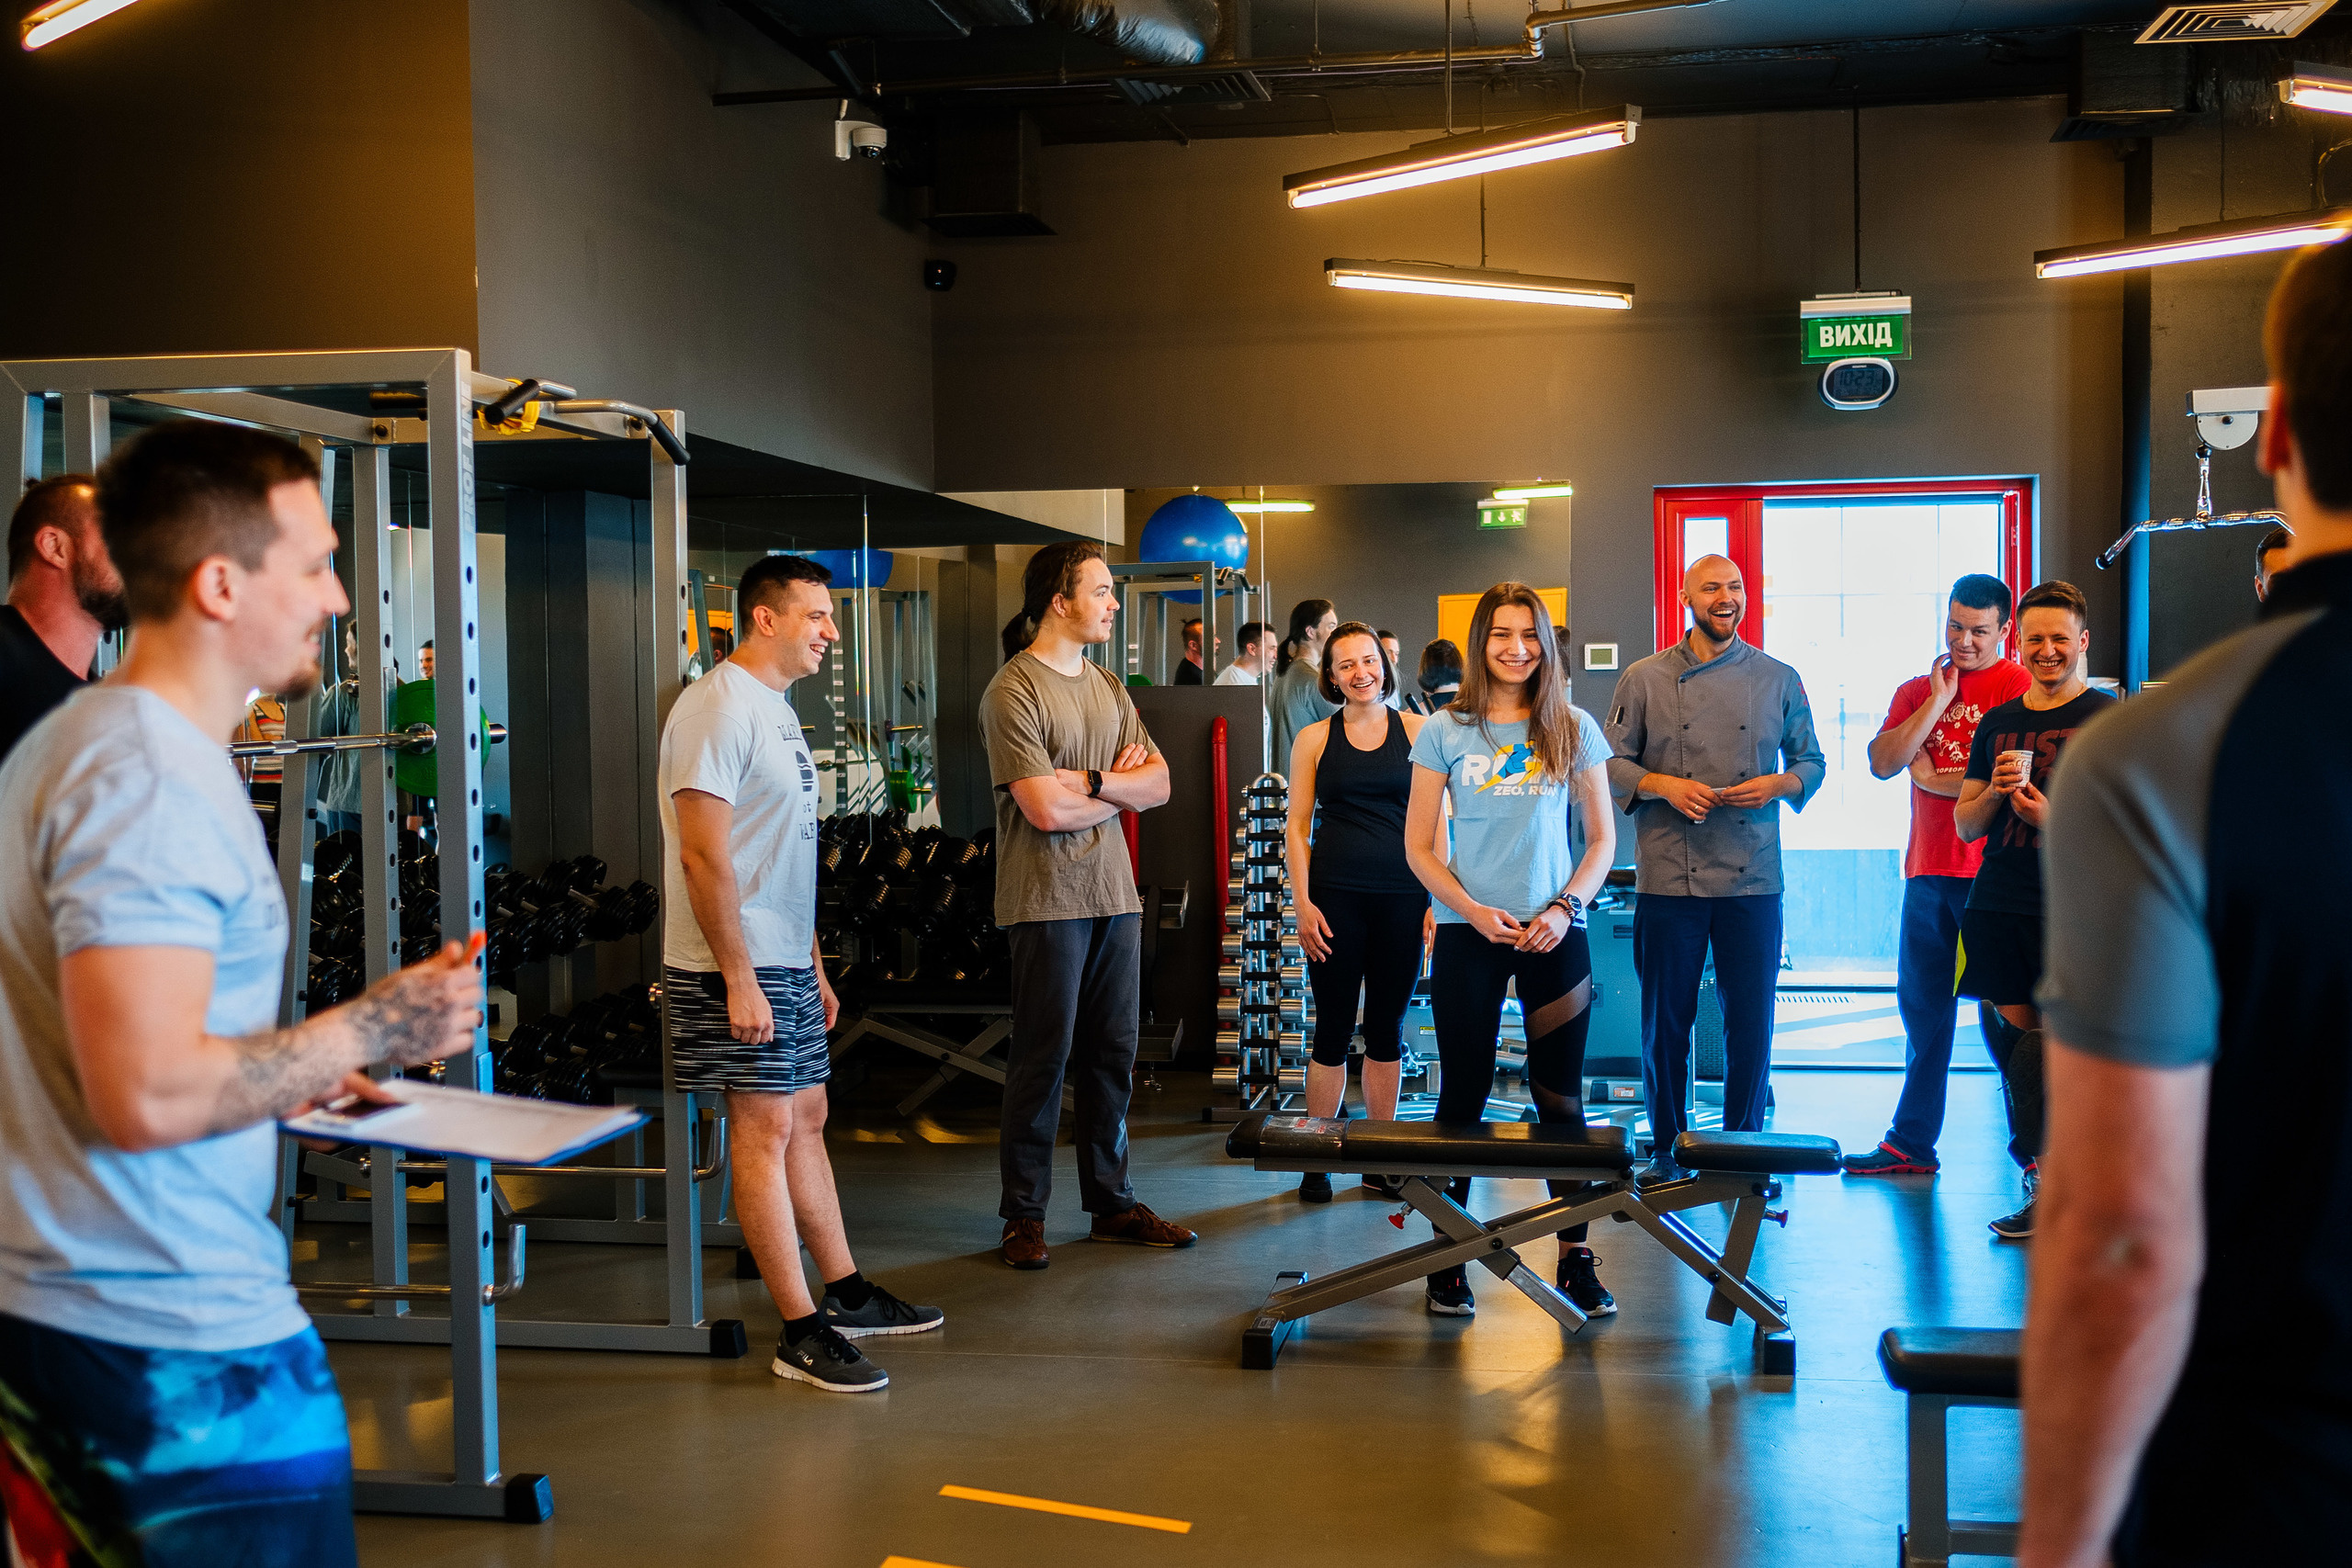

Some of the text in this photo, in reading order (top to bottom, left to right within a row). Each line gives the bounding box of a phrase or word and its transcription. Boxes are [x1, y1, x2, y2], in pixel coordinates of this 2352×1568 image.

[1819, 321, 1893, 348] ВИХІД
[460, 381, 476, 536] PROF LINE
[1493, 785, 1525, 796] ZEO,
[797, 1349, 813, 1366] FILA
